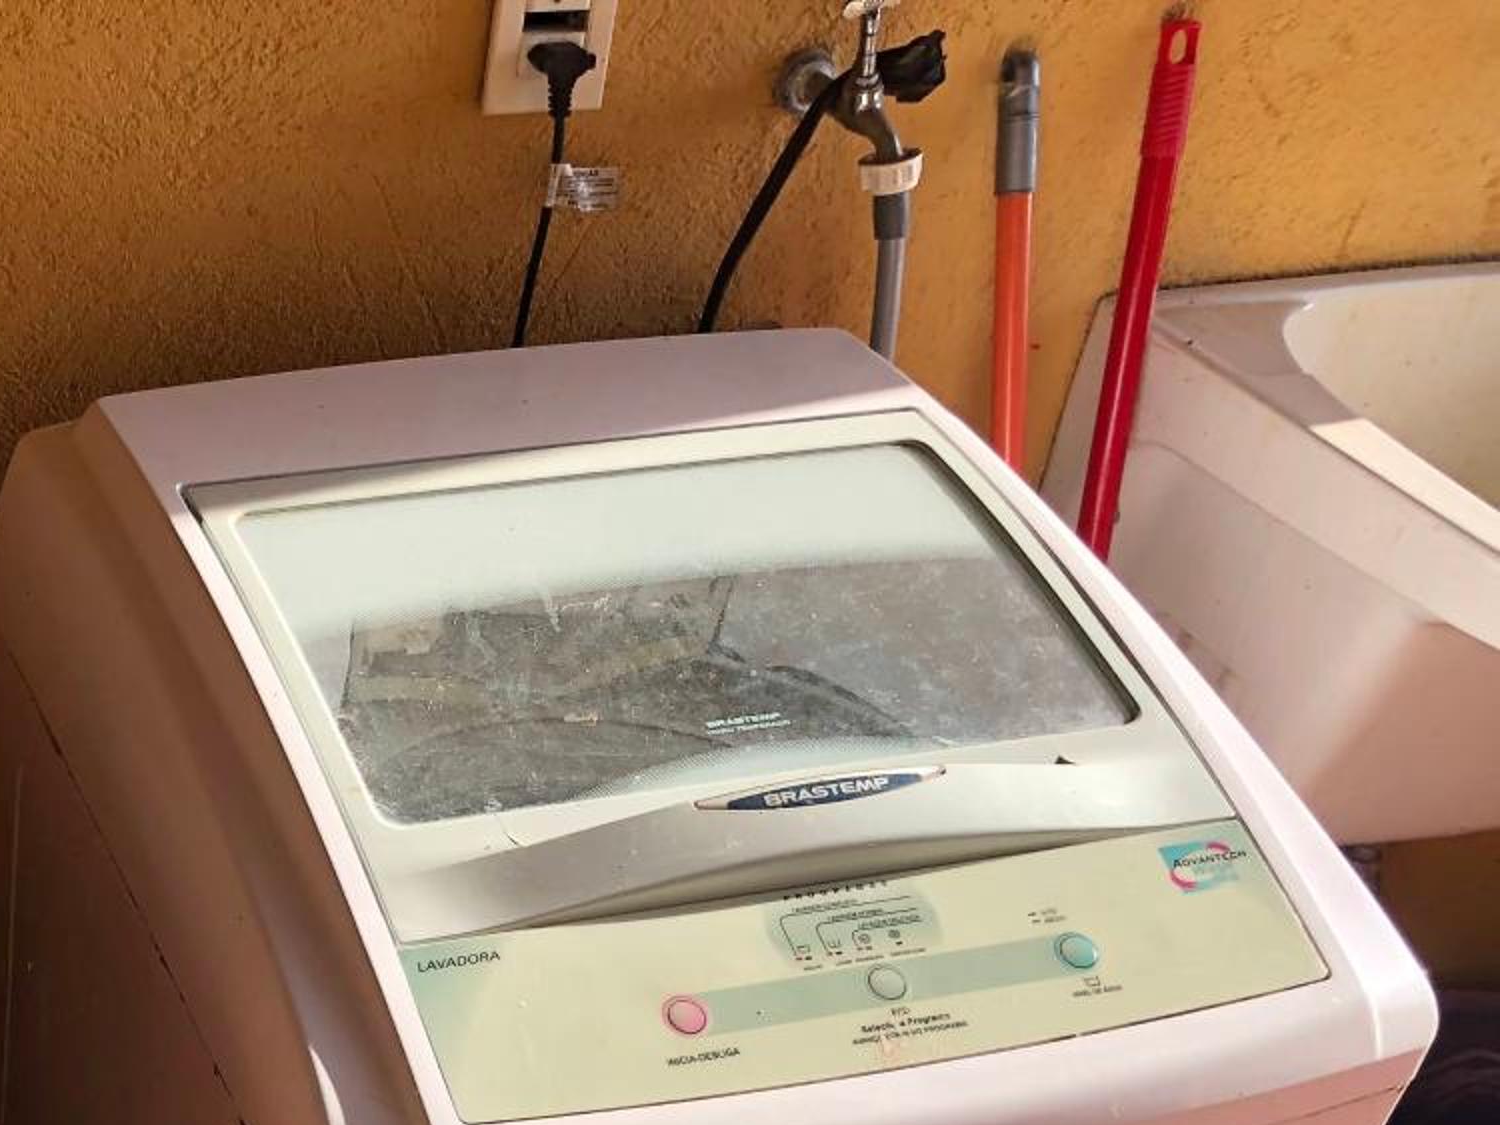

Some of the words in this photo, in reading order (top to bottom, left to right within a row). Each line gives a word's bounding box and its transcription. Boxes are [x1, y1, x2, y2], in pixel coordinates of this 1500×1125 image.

[706, 711, 780, 729] BRASTEMP
[763, 777, 889, 808] BRASTEMP
[1173, 850, 1247, 868] ADVANTECH
[417, 950, 501, 973] LAVADORA
